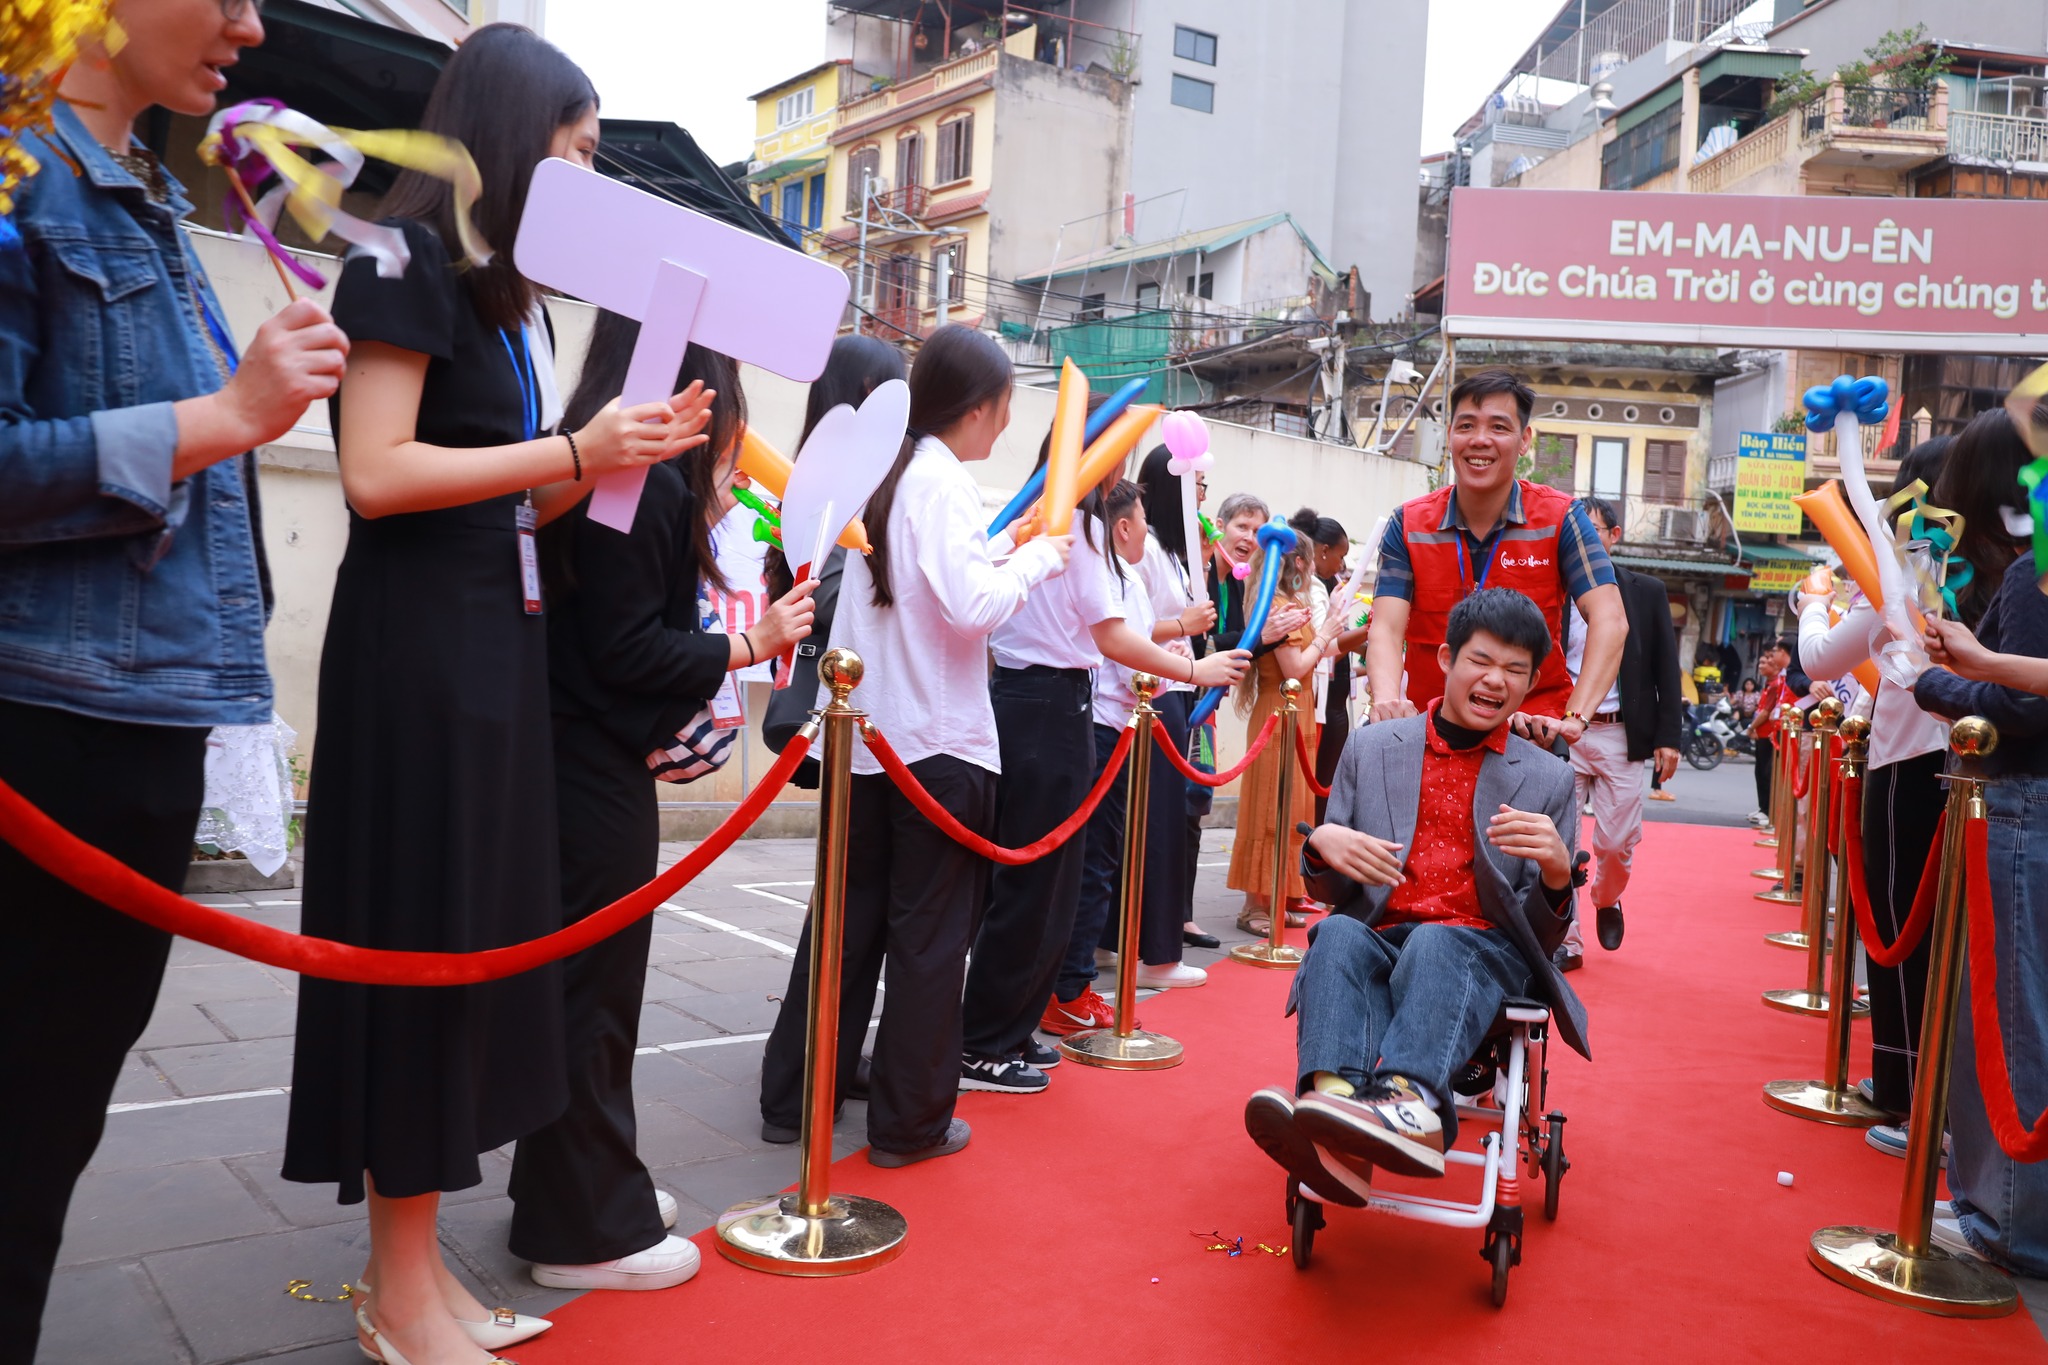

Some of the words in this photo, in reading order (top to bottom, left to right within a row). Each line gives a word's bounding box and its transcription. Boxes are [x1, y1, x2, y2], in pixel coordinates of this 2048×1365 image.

[1609, 218, 1934, 265] EM-MA-NU-ÊN
[1473, 261, 1550, 297] Đức
[1557, 264, 1658, 300] Chúa
[1666, 267, 1741, 303] Trời
[1749, 268, 1776, 305] ở
[1783, 271, 1884, 316] cùng
[1893, 274, 2021, 319] chúng
[2030, 278, 2048, 311] t
[1768, 462, 1795, 472] CHỮA
